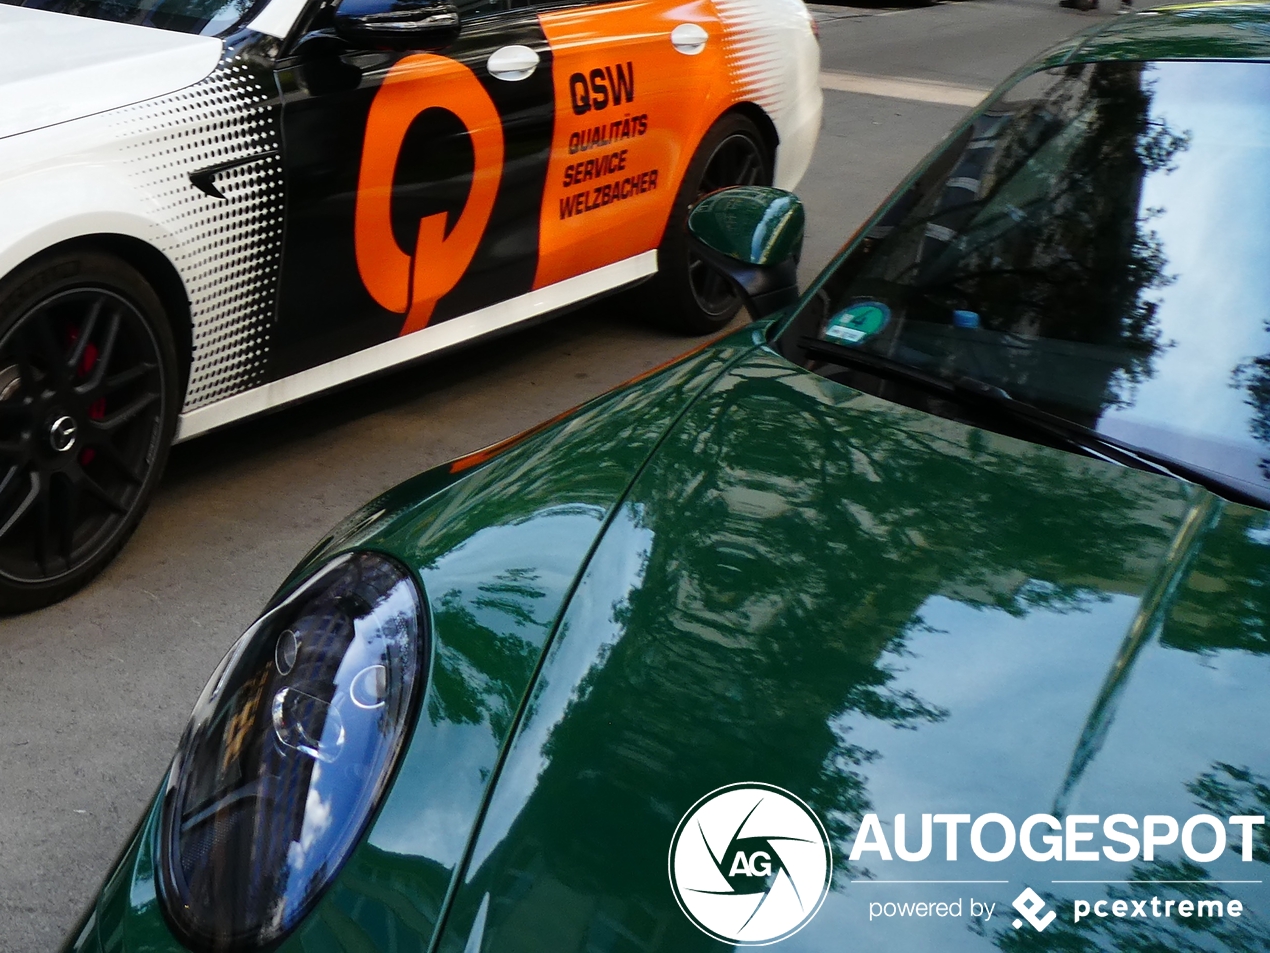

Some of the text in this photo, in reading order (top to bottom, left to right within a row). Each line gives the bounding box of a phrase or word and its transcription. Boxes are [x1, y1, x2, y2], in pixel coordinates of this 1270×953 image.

[568, 61, 635, 116] QSW
[567, 113, 648, 156] QUALITÄTS
[353, 52, 505, 337] Q
[562, 149, 628, 188] SERVICE
[558, 169, 658, 221] WELZBACHER
